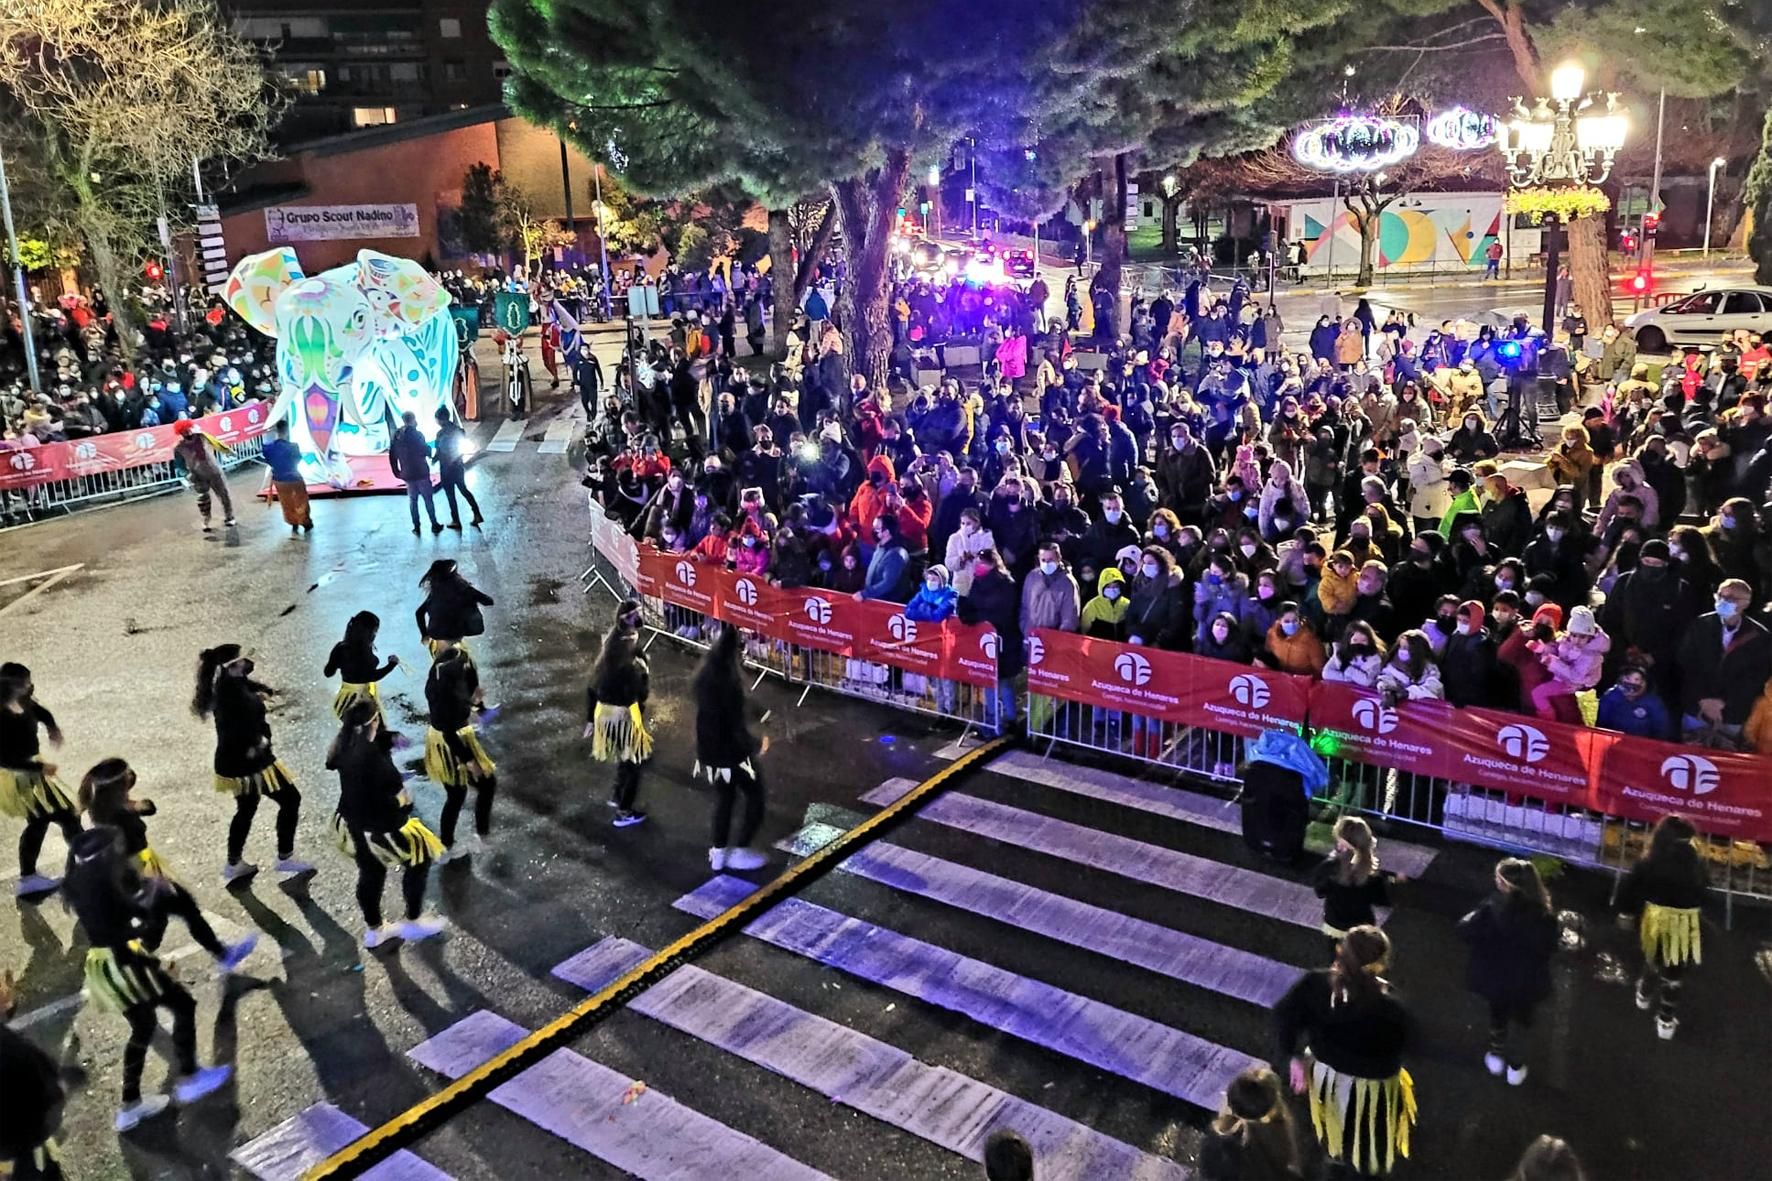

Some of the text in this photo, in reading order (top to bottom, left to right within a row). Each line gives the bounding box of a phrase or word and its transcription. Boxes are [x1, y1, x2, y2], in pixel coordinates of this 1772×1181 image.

[287, 209, 394, 224] Grupo Scout Nadino
[1091, 679, 1131, 695] Azuqueca
[1132, 688, 1143, 697] de
[1144, 690, 1180, 704] Henares
[1203, 702, 1246, 719] Azuqueca
[1248, 711, 1260, 721] de
[1323, 727, 1371, 744] Azuqueca
[1373, 737, 1387, 747] de
[1389, 739, 1433, 755] Henares
[1463, 753, 1518, 772] Azuqueca
[1520, 765, 1536, 776] de
[1538, 768, 1587, 786] Henares
[1622, 786, 1684, 807] Azuqueca
[1687, 799, 1704, 809] de
[1707, 801, 1762, 818] Henares
